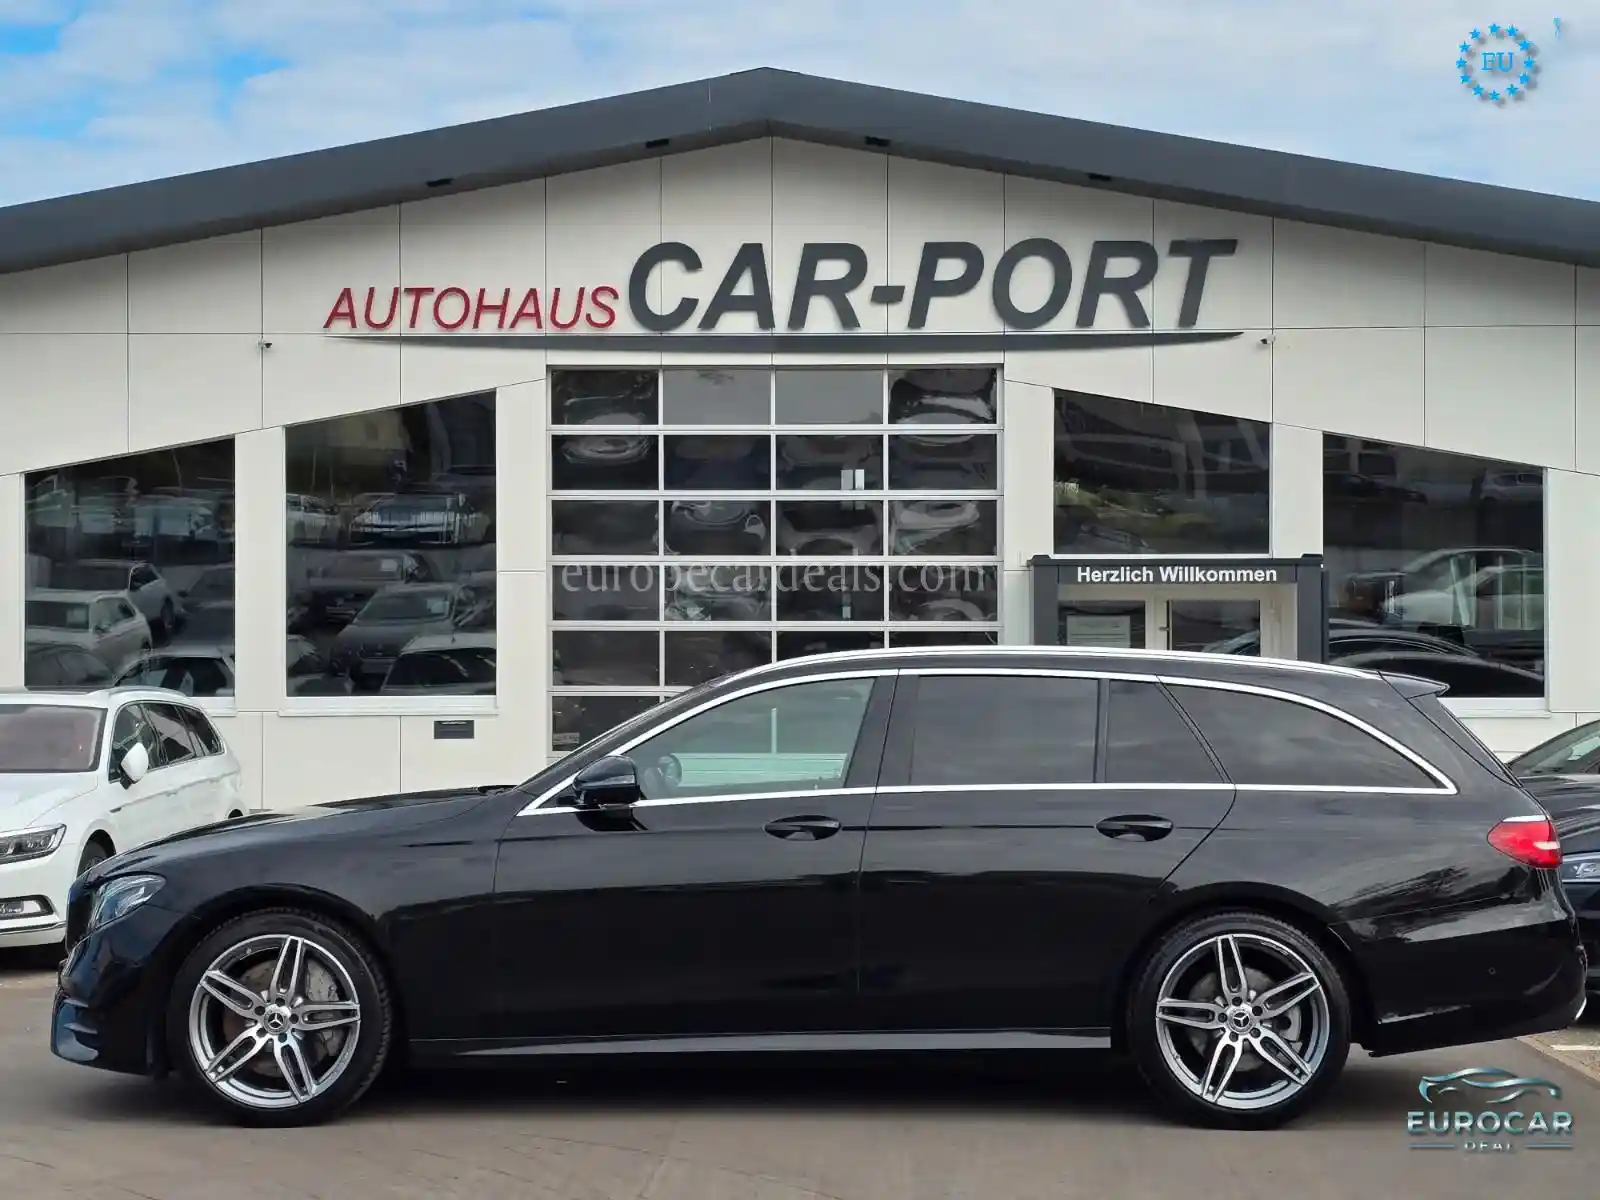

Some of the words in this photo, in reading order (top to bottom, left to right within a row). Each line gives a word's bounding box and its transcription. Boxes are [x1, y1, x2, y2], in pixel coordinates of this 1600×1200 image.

[322, 285, 620, 330] AUTOHAUS
[628, 238, 1238, 333] CAR-PORT
[1076, 566, 1154, 583] Herzlich
[1159, 566, 1278, 583] Willkommen
